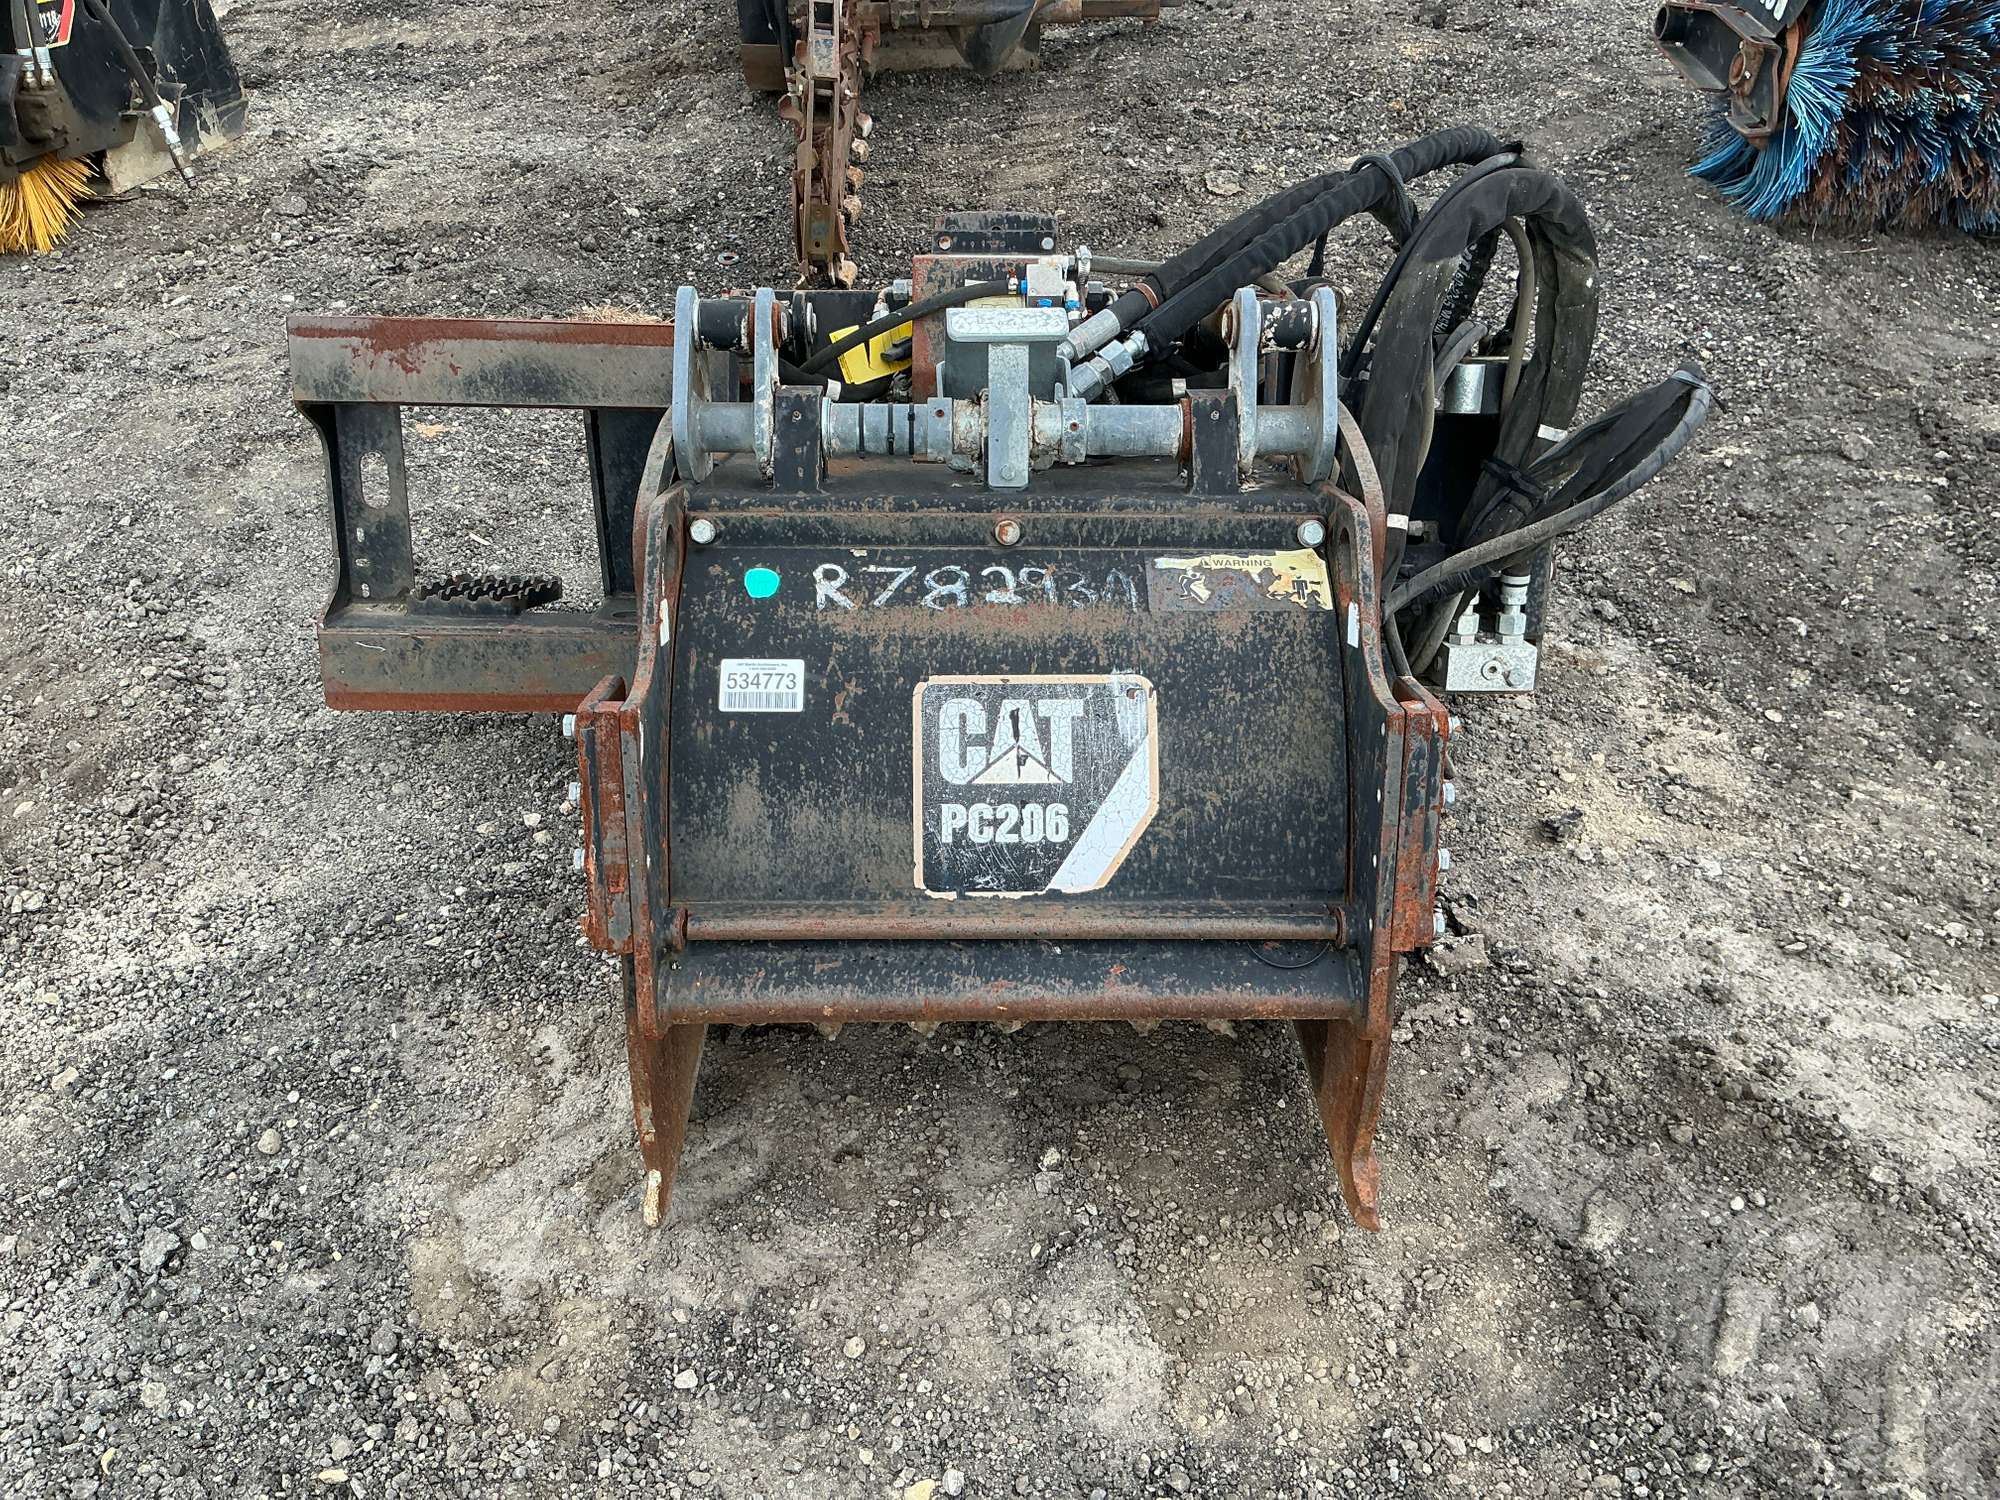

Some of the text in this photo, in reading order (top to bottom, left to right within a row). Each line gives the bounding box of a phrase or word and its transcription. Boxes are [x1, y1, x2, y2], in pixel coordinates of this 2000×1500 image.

[1212, 558, 1273, 568] WARNING
[726, 672, 797, 690] 534773
[939, 698, 1084, 785] CAT
[940, 802, 1070, 844] PC206
